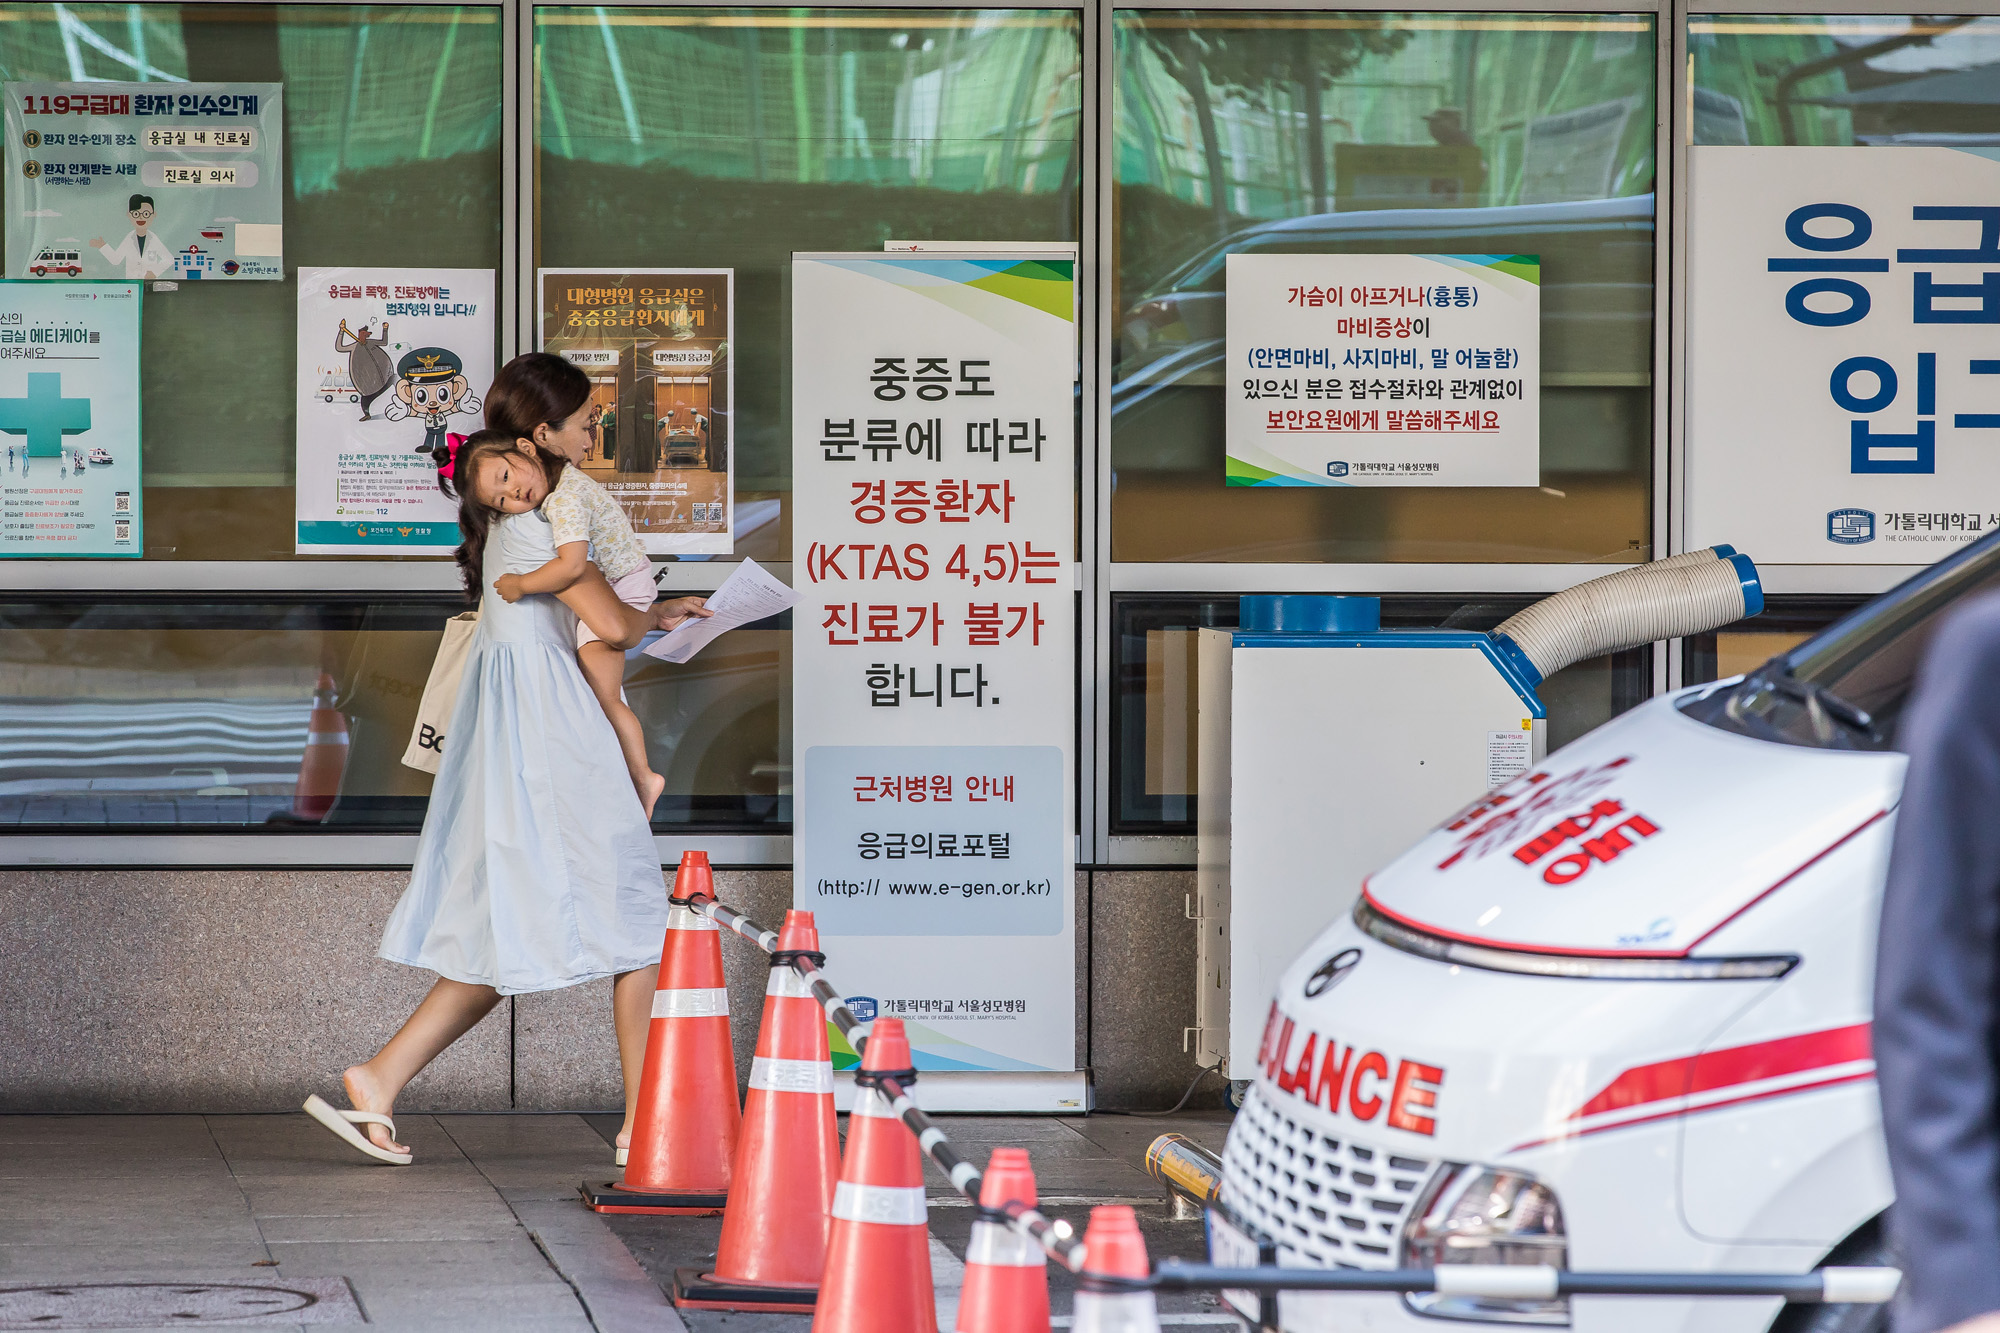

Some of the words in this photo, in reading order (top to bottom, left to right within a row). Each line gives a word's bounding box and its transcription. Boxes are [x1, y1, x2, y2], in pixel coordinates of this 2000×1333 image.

[23, 94, 129, 116] 119구급대
[134, 94, 174, 116] 환자
[178, 94, 258, 116] 인수인계
[43, 135, 65, 146] 환자
[115, 135, 137, 146] 장소
[149, 131, 187, 146] 응급실
[194, 131, 206, 146] 내
[213, 131, 250, 146] 진료실
[43, 163, 65, 175] 환자
[68, 163, 112, 175] 인계받는
[115, 163, 137, 175] 사람
[165, 169, 202, 183] 진료실
[209, 169, 235, 183] 의사
[74, 176, 91, 185] 사람)
[1767, 202, 2000, 327] 응급
[328, 284, 362, 299] 응급실
[365, 285, 391, 300] 폭행,
[394, 285, 450, 300] 진료방해는
[567, 288, 634, 305] 대형병원
[639, 288, 706, 306] 응급실은
[1288, 285, 1344, 308] 가슴이
[1350, 285, 1479, 308] 아프거나(흉통)
[0, 313, 23, 325] 신의
[386, 303, 430, 317] 범죄행위
[434, 303, 477, 317] 입니다!!
[568, 309, 705, 327] 중증응급환자에게
[0, 329, 26, 343] 급실
[30, 328, 100, 343] 에티케어를
[1337, 317, 1430, 339] 마비증상이
[0, 347, 46, 359] 여주세요
[655, 353, 687, 362] 대형병원
[688, 353, 712, 362] 응급실
[1248, 347, 1336, 371] (안면마비,
[1343, 347, 1424, 371] 사지마비,
[1431, 347, 1449, 369] 말
[1455, 347, 1519, 370] 어눌함)
[870, 357, 995, 401] 중증도
[1243, 378, 1298, 400] 있으신
[1305, 378, 1344, 400] 분은
[1350, 378, 1444, 400] 접수절차와
[1450, 378, 1523, 401] 관계없이
[1267, 409, 1379, 431] 보안요원에게
[1386, 409, 1500, 431] 말씀해주세요
[819, 418, 941, 462] 분류에
[966, 418, 1047, 462] 따라
[1352, 462, 1395, 472] 가톨릭대학교
[1398, 462, 1440, 472] 서울성모병원
[850, 479, 1015, 524] 경증환자
[1832, 509, 1871, 517] CATHOLIC
[1884, 513, 1982, 531] 가톨릭대학교
[1885, 534, 1896, 542] THE
[1898, 534, 1929, 542] CATHOLIC
[1931, 534, 1949, 542] UNIV.
[1950, 534, 1958, 542] OF
[1959, 534, 1981, 542] KOREA
[806, 541, 930, 584] (KTAS
[945, 541, 1060, 588] 4,5)는
[821, 602, 944, 646] 진료가
[963, 602, 1045, 646] 불가
[866, 663, 1000, 708] 합니다.
[853, 774, 953, 803] 근처병원
[965, 775, 1015, 803] 안내
[857, 832, 1011, 860] 응급의료포털
[817, 878, 880, 899] (http://
[889, 878, 1051, 899] www.e-gen.or.kr)
[884, 999, 954, 1013] 가톨릭대학교
[958, 999, 1026, 1013] 서울성모병원
